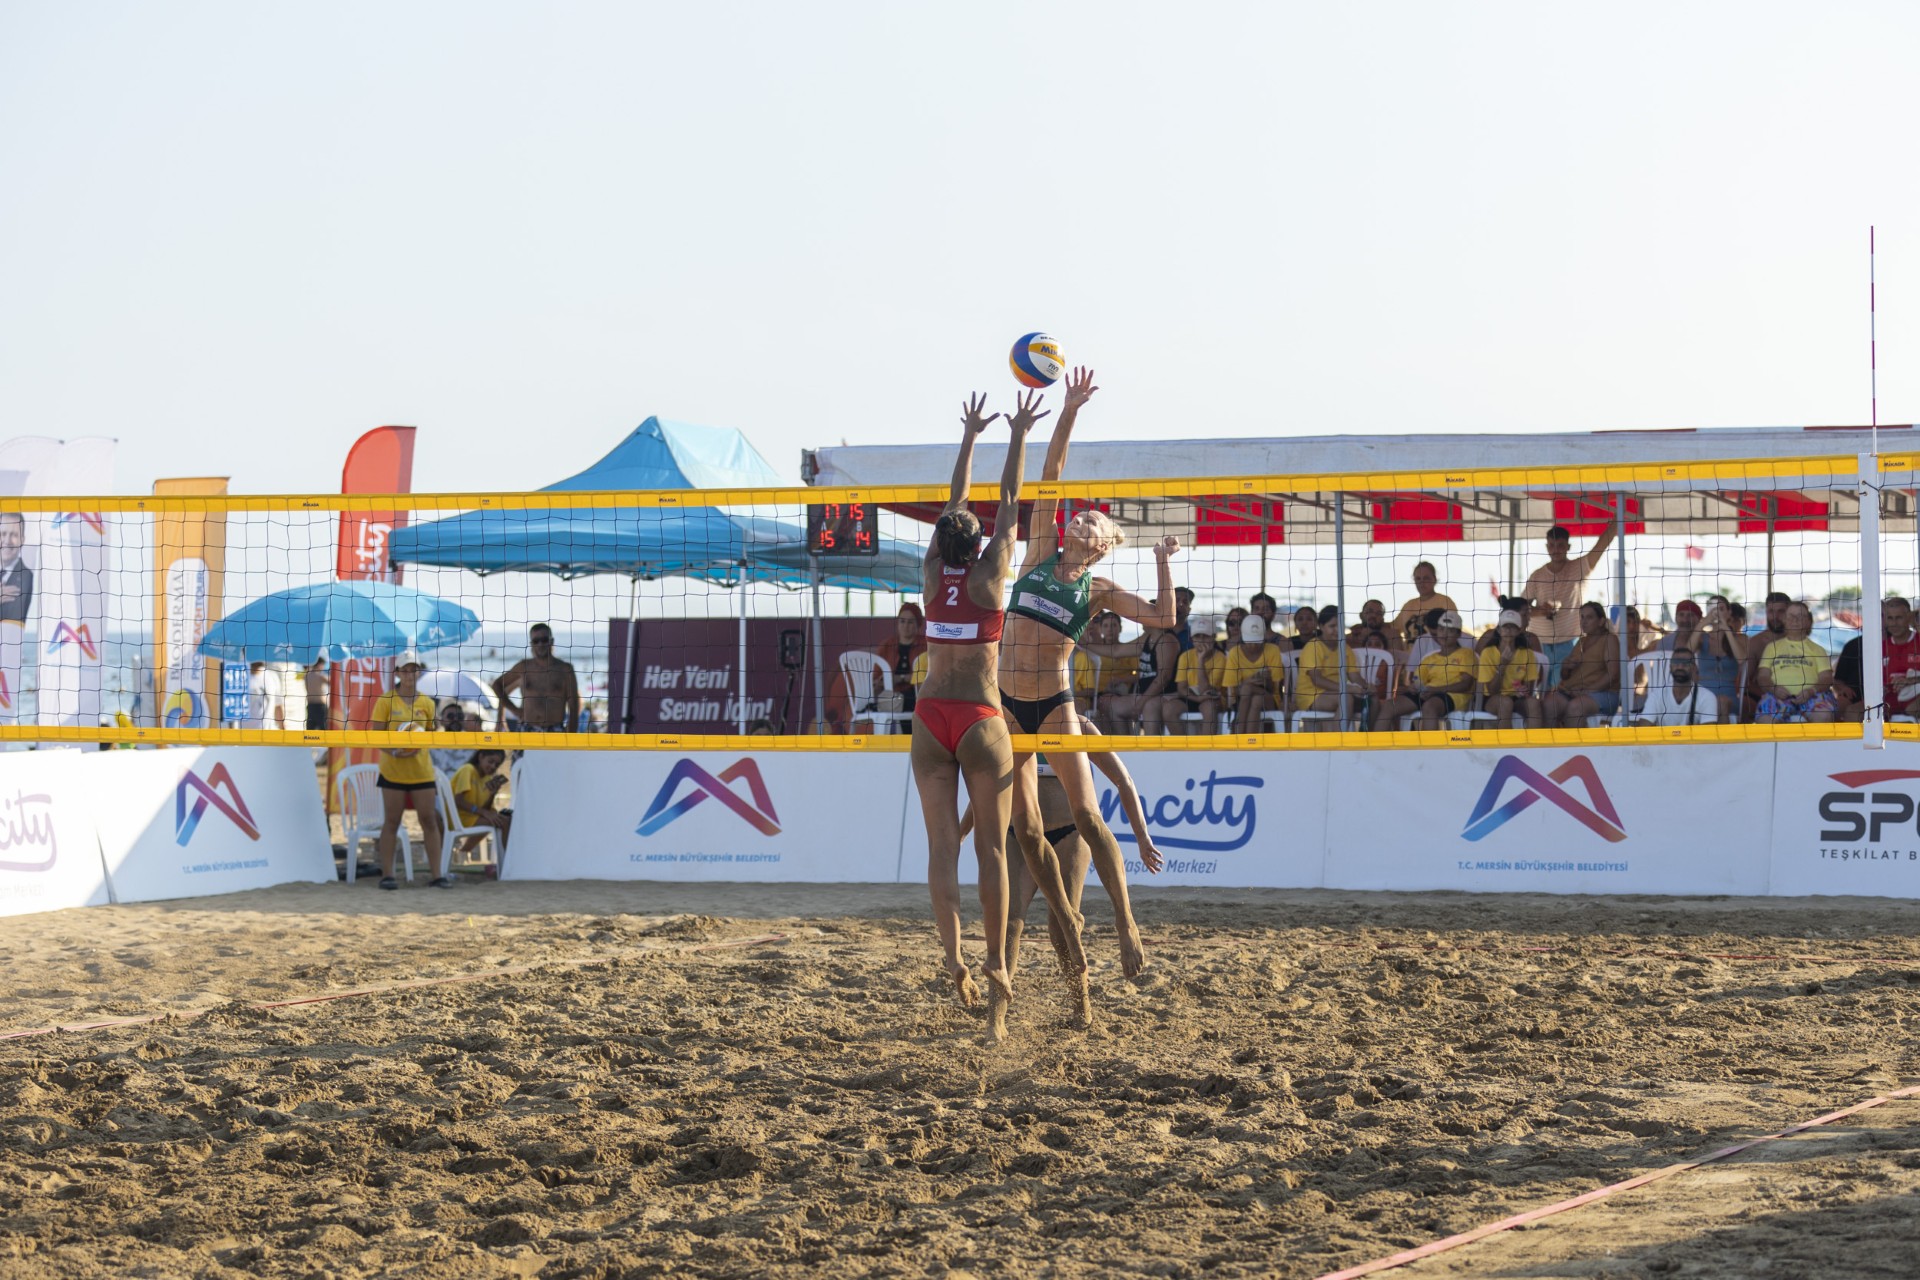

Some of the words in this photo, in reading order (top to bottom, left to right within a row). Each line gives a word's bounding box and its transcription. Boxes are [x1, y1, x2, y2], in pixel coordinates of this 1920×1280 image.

[850, 503, 864, 520] 15
[820, 530, 835, 548] 15
[855, 531, 870, 547] 14
[946, 586, 958, 606] 2
[643, 665, 682, 689] Her
[685, 664, 730, 689] Yeni
[659, 697, 720, 721] Senin
[1819, 792, 1920, 842] SP
[630, 854, 644, 862] T.C.
[645, 853, 677, 862] MERSİN
[680, 852, 733, 863] BÜYÜKŞEHİR
[735, 853, 781, 862] BELEDİYESİ
[1820, 848, 1899, 861] TEŞKİLAT
[1166, 859, 1218, 874] Merkezi
[1457, 861, 1473, 870] T.C.
[1476, 860, 1512, 870] MERSİN
[1514, 860, 1574, 872] BÜYÜKŞEHİR
[1577, 860, 1628, 871] BELEDİYESİ
